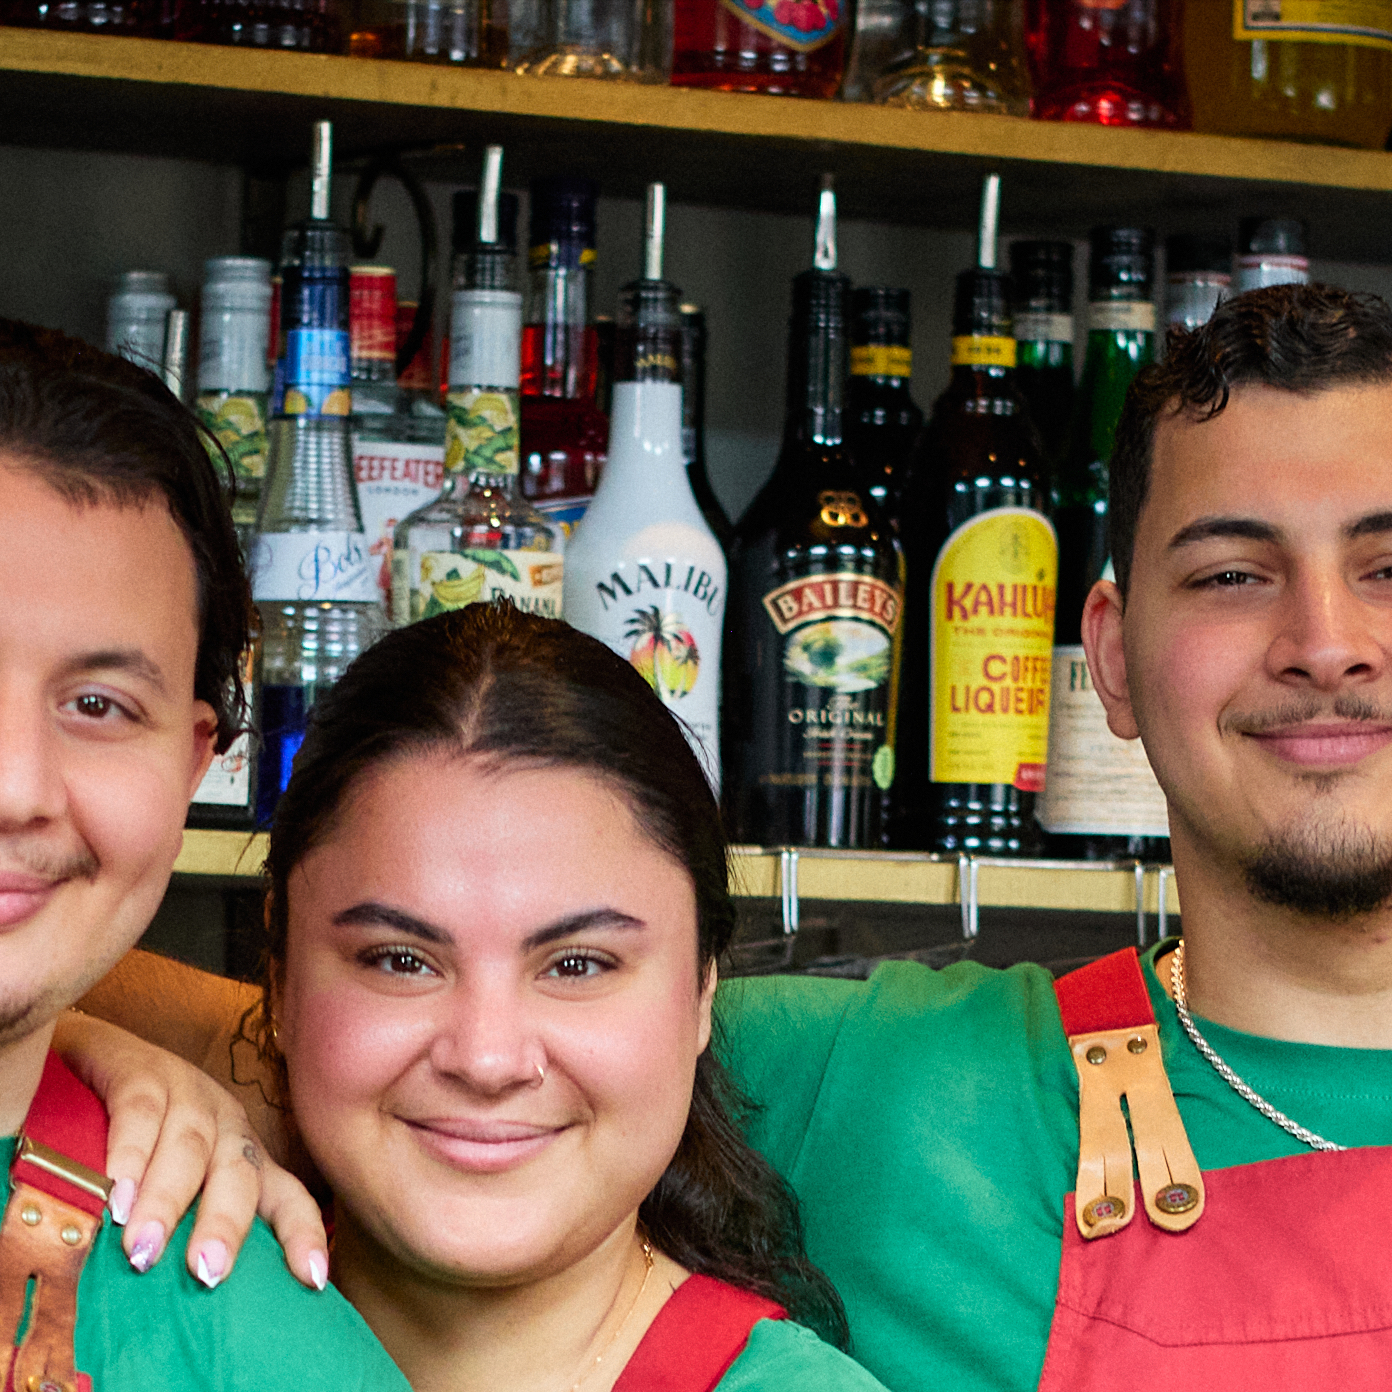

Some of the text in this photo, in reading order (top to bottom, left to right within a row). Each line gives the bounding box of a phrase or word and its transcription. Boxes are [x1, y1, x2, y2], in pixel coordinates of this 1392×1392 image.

[596, 562, 720, 616] MALIBU
[777, 582, 896, 621] BAILEYS
[789, 709, 883, 726] ORIGINAL
